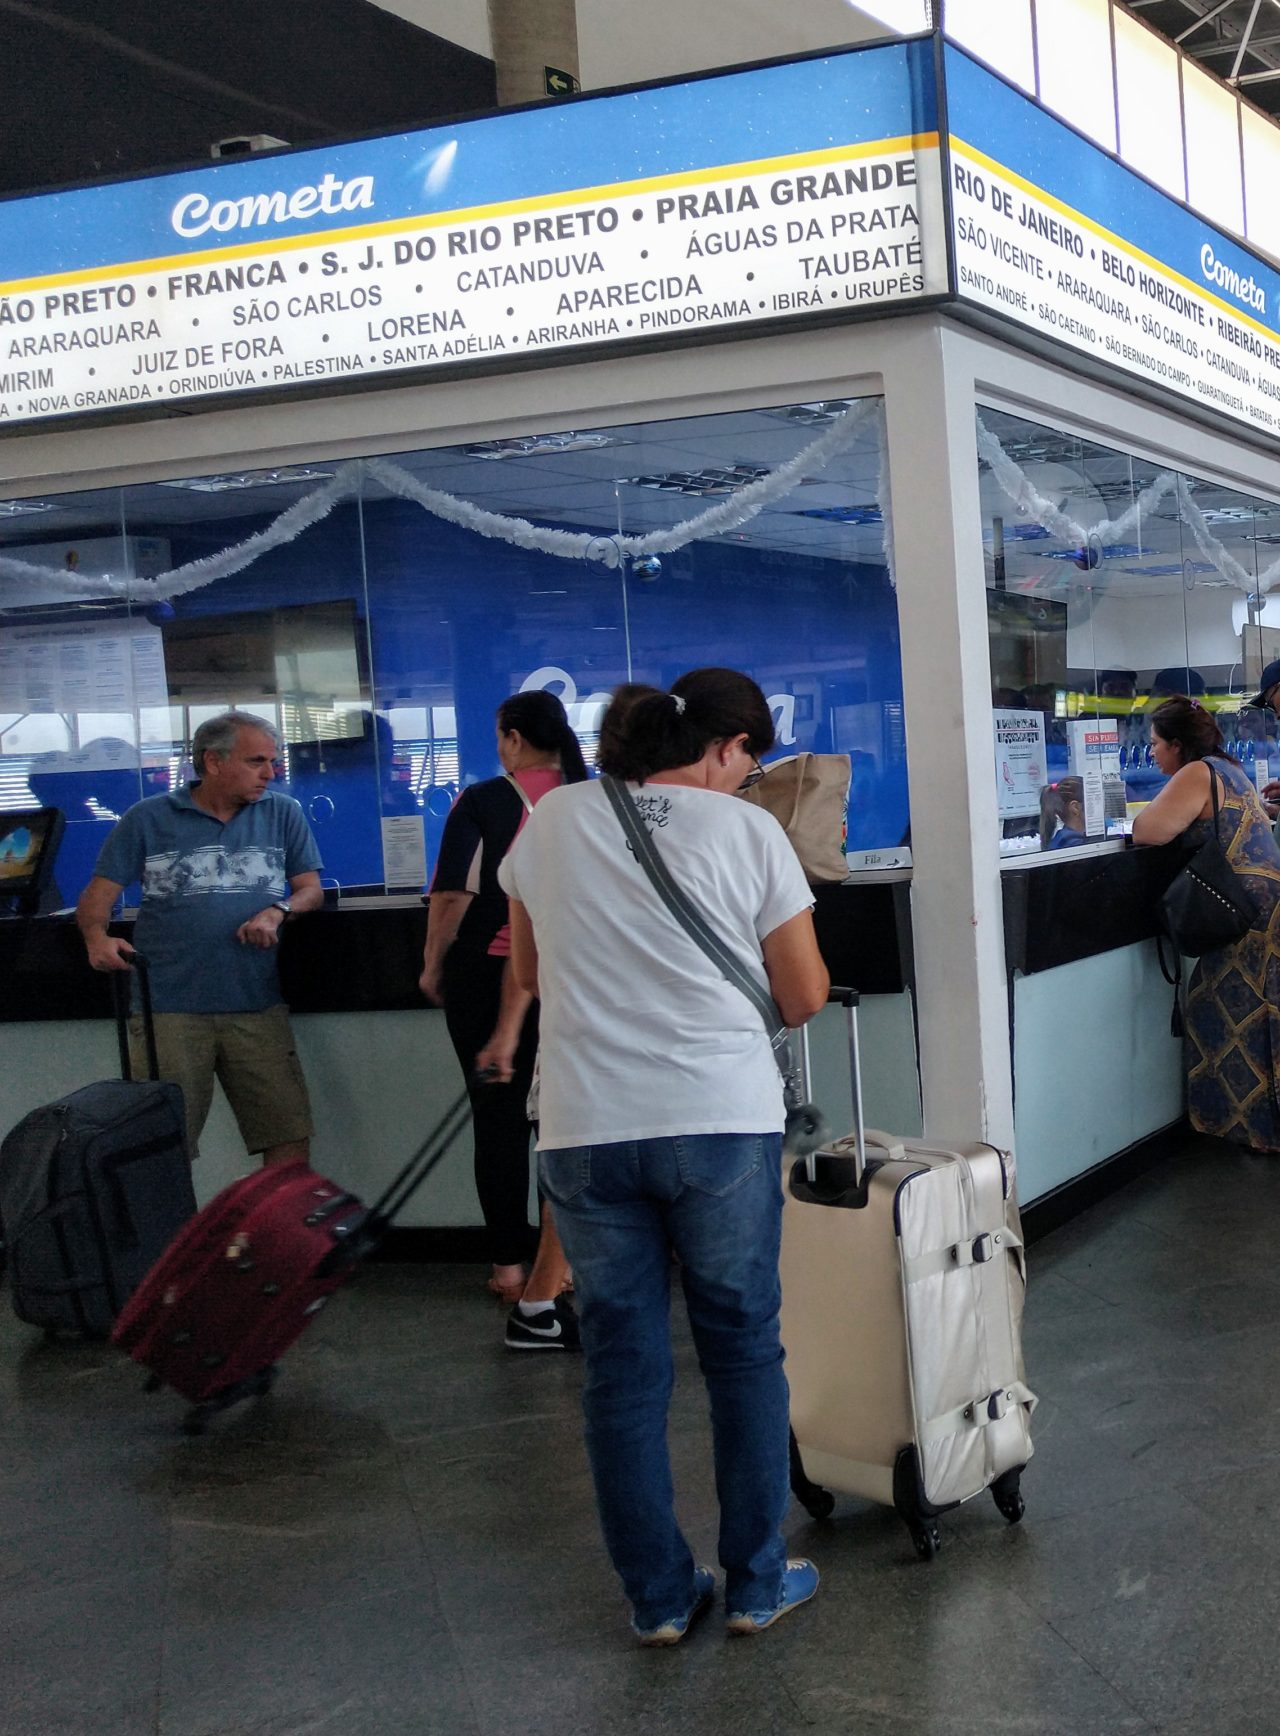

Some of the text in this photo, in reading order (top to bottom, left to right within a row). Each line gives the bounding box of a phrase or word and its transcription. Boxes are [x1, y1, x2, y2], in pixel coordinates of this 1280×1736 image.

[44, 281, 136, 319] PRETO
[168, 258, 287, 300] FRANCA
[320, 248, 348, 277] S.
[357, 242, 383, 271] J.
[393, 234, 436, 265] DO
[447, 224, 502, 257] RIO
[512, 205, 619, 247] PRETO
[655, 183, 760, 225] PRAIA
[769, 158, 917, 207] GRANDE
[172, 173, 375, 238] Cometa
[953, 162, 986, 205] RIO
[991, 184, 1013, 220] DE
[1018, 200, 1083, 259] JANEIRO
[1101, 248, 1135, 288] BELO
[1139, 270, 1204, 327] HORIZONTE
[1217, 316, 1261, 359] RIBEIRÃO
[8, 202, 920, 359] ARARAQUARA SÃO CARLOS CATANDUVA ÁGUAS DA PRATA
[28, 393, 70, 413] NOVA
[74, 382, 152, 407] GRANADA
[168, 367, 256, 394] ORINDIÚVA
[273, 352, 364, 380] PALESTINA
[382, 342, 438, 365] SANTA
[442, 332, 505, 357] ADÉLIA
[525, 316, 619, 345] ARIRANHA
[639, 298, 751, 329] PINDORAMA
[772, 284, 824, 311] IBIRÁ
[844, 272, 924, 301] URUPÊS
[132, 349, 178, 375] JUIZ
[185, 343, 214, 368] DE
[221, 334, 284, 362] FORA
[367, 307, 465, 342] LORENA
[555, 272, 703, 315] APARECIDA
[798, 235, 923, 280] TAUBATÉ
[957, 216, 986, 252] SÃO
[990, 233, 1043, 281] VICENTE
[1057, 268, 1131, 325] ARARAQUARA
[1141, 313, 1161, 341] SÃO
[1163, 324, 1198, 359] CARLOS
[1206, 347, 1250, 386] CATANDUVA
[1257, 372, 1280, 402] ÁGUAS
[960, 265, 994, 296] SANTO
[995, 281, 1027, 312] ANDRÉ
[1038, 302, 1056, 325] SÃO
[1058, 311, 1096, 344] CAETANO
[1105, 334, 1121, 355] SÃO
[1121, 342, 1155, 371] BERNADO
[1156, 359, 1167, 377] DO
[1167, 364, 1190, 387] CAMPO
[1200, 243, 1266, 313] Cometa
[640, 811, 668, 827] ance
[864, 855, 881, 864] Fila
